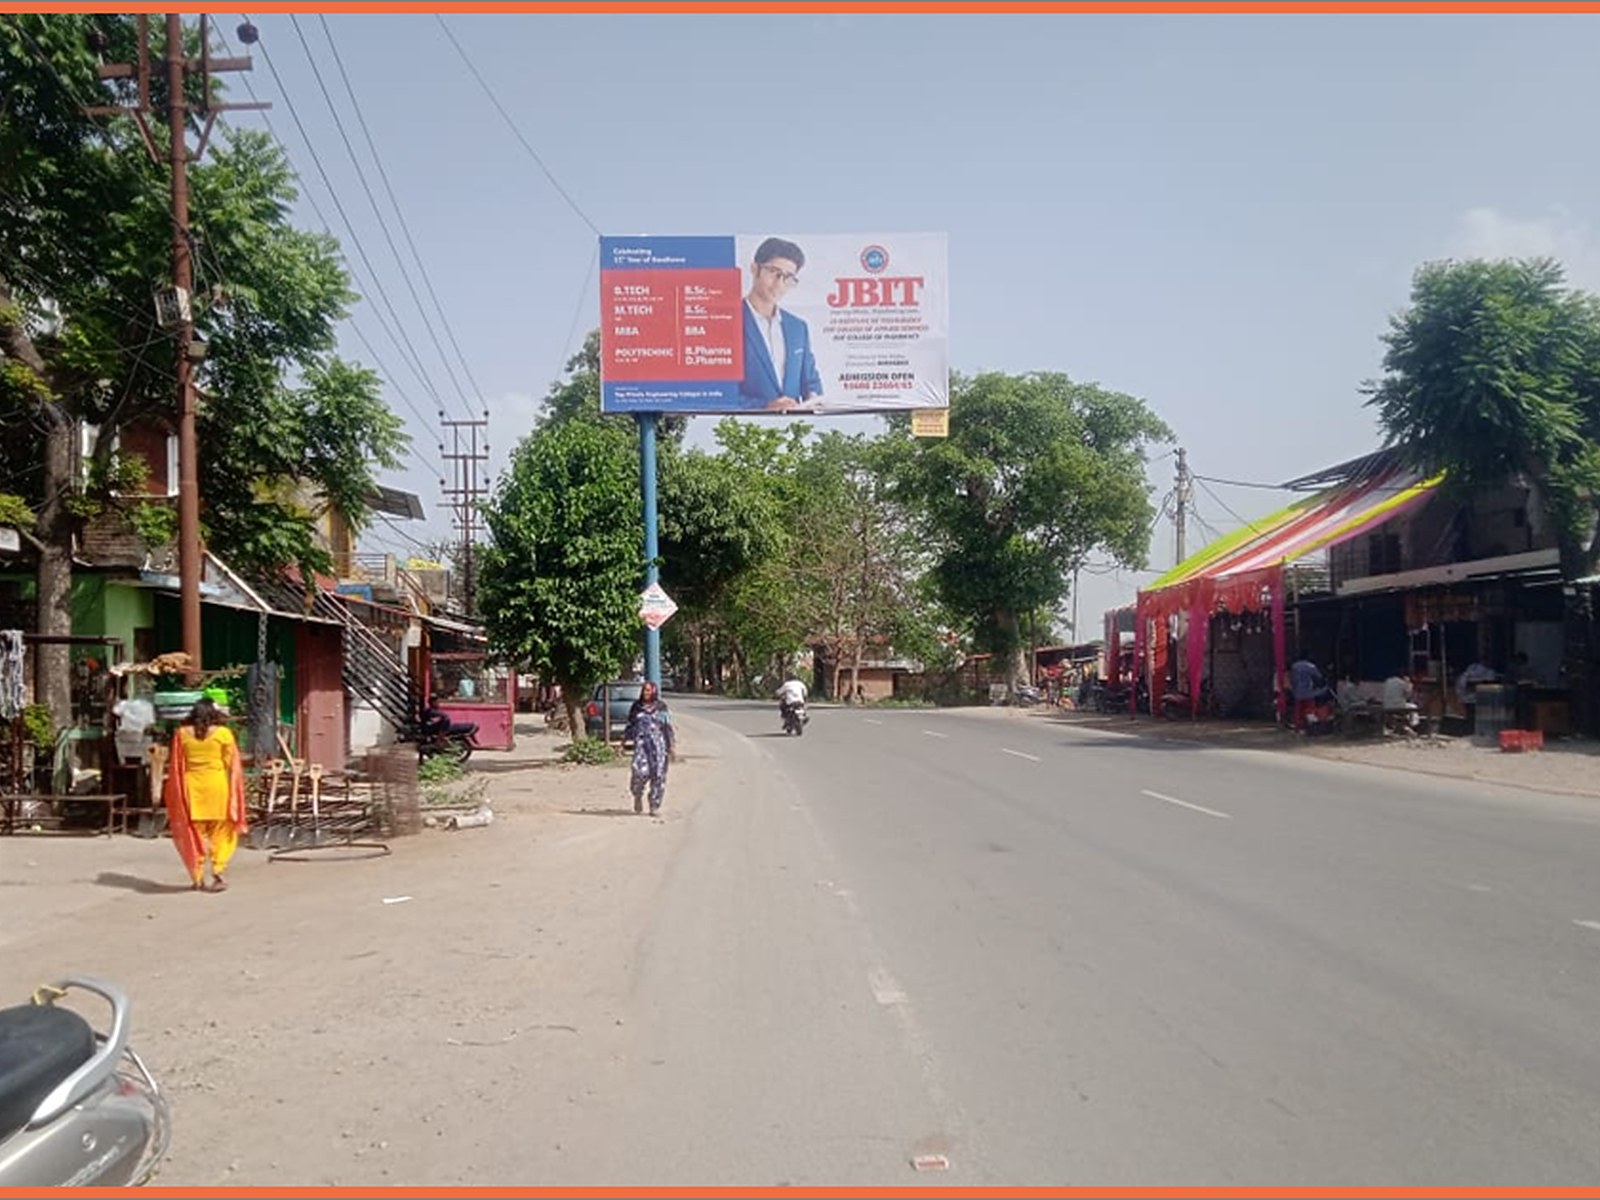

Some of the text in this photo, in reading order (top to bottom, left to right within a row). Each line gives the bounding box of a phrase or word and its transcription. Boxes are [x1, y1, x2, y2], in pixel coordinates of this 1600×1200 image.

[614, 286, 650, 295] B.TECH
[827, 277, 924, 308] JBIT
[615, 305, 653, 315] M.TECH
[615, 326, 640, 336] MBA
[684, 326, 706, 336] BBA
[615, 348, 674, 357] POLYTECHNIC
[685, 346, 732, 355] B.Pharma
[685, 356, 732, 365] D.Pharma
[839, 372, 915, 381] ADMISSION OPEN
